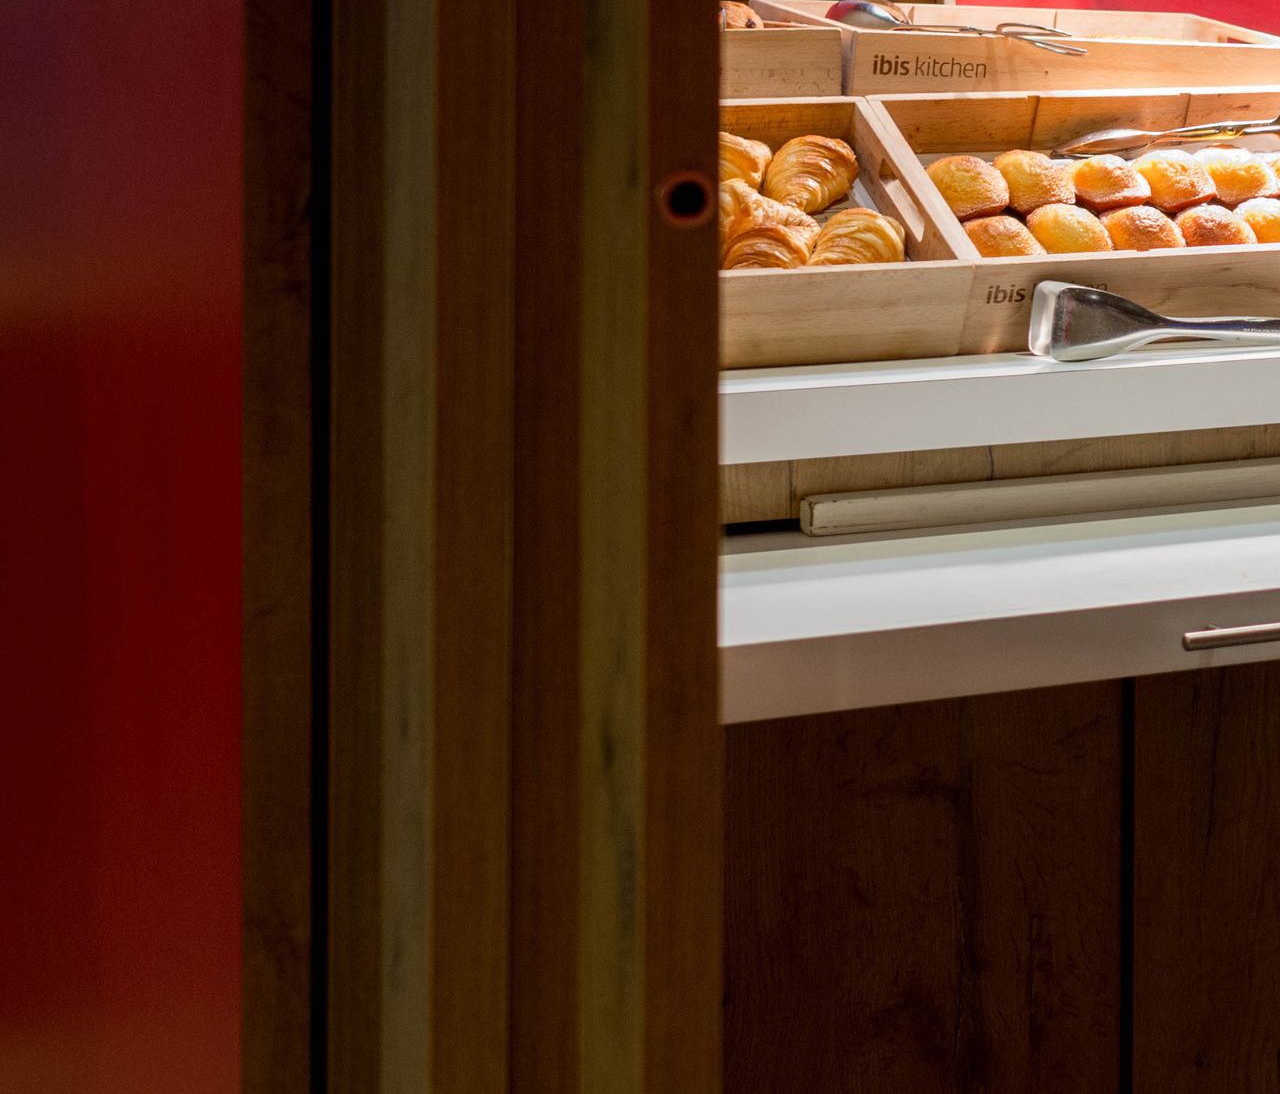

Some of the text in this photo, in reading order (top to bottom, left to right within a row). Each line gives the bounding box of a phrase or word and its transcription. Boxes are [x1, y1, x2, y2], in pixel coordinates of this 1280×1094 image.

[873, 55, 987, 78] ibis kitchen
[986, 284, 1026, 304] ibis
